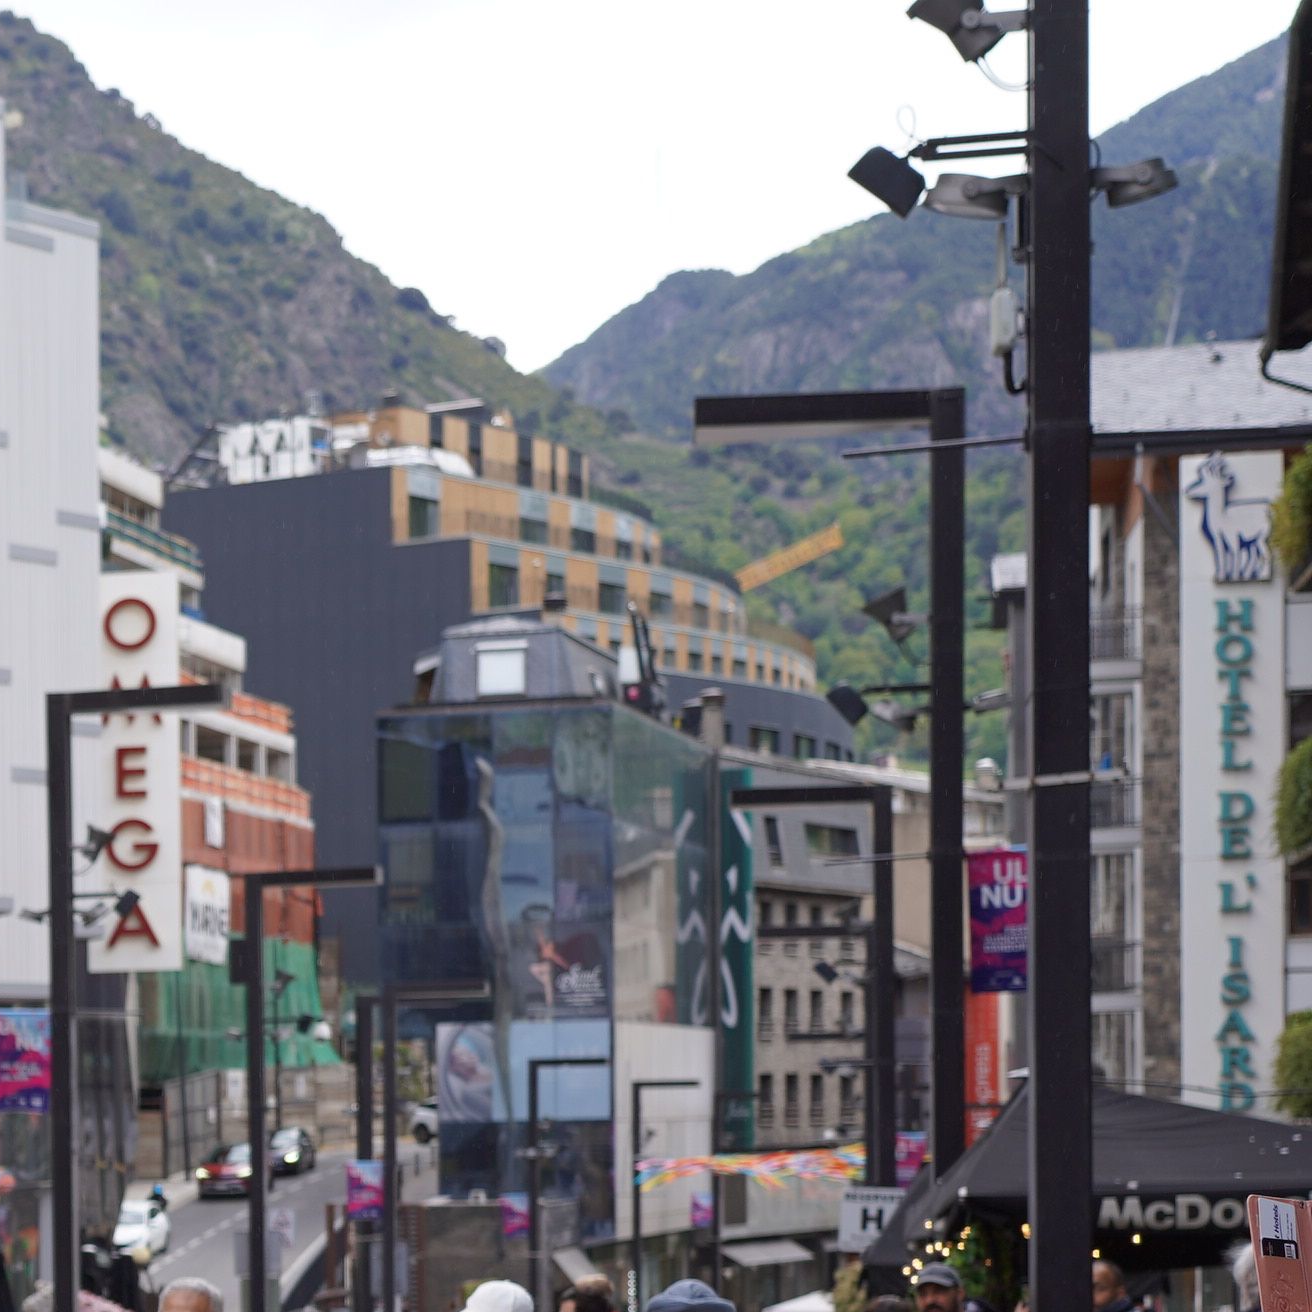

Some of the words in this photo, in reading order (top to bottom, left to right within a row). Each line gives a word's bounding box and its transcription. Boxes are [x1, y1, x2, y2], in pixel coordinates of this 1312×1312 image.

[1214, 598, 1256, 772] HOTEL
[102, 598, 162, 950] OMEGA
[1218, 791, 1256, 861] DE
[862, 1207, 884, 1231] H
[1097, 1193, 1249, 1230] McDo
